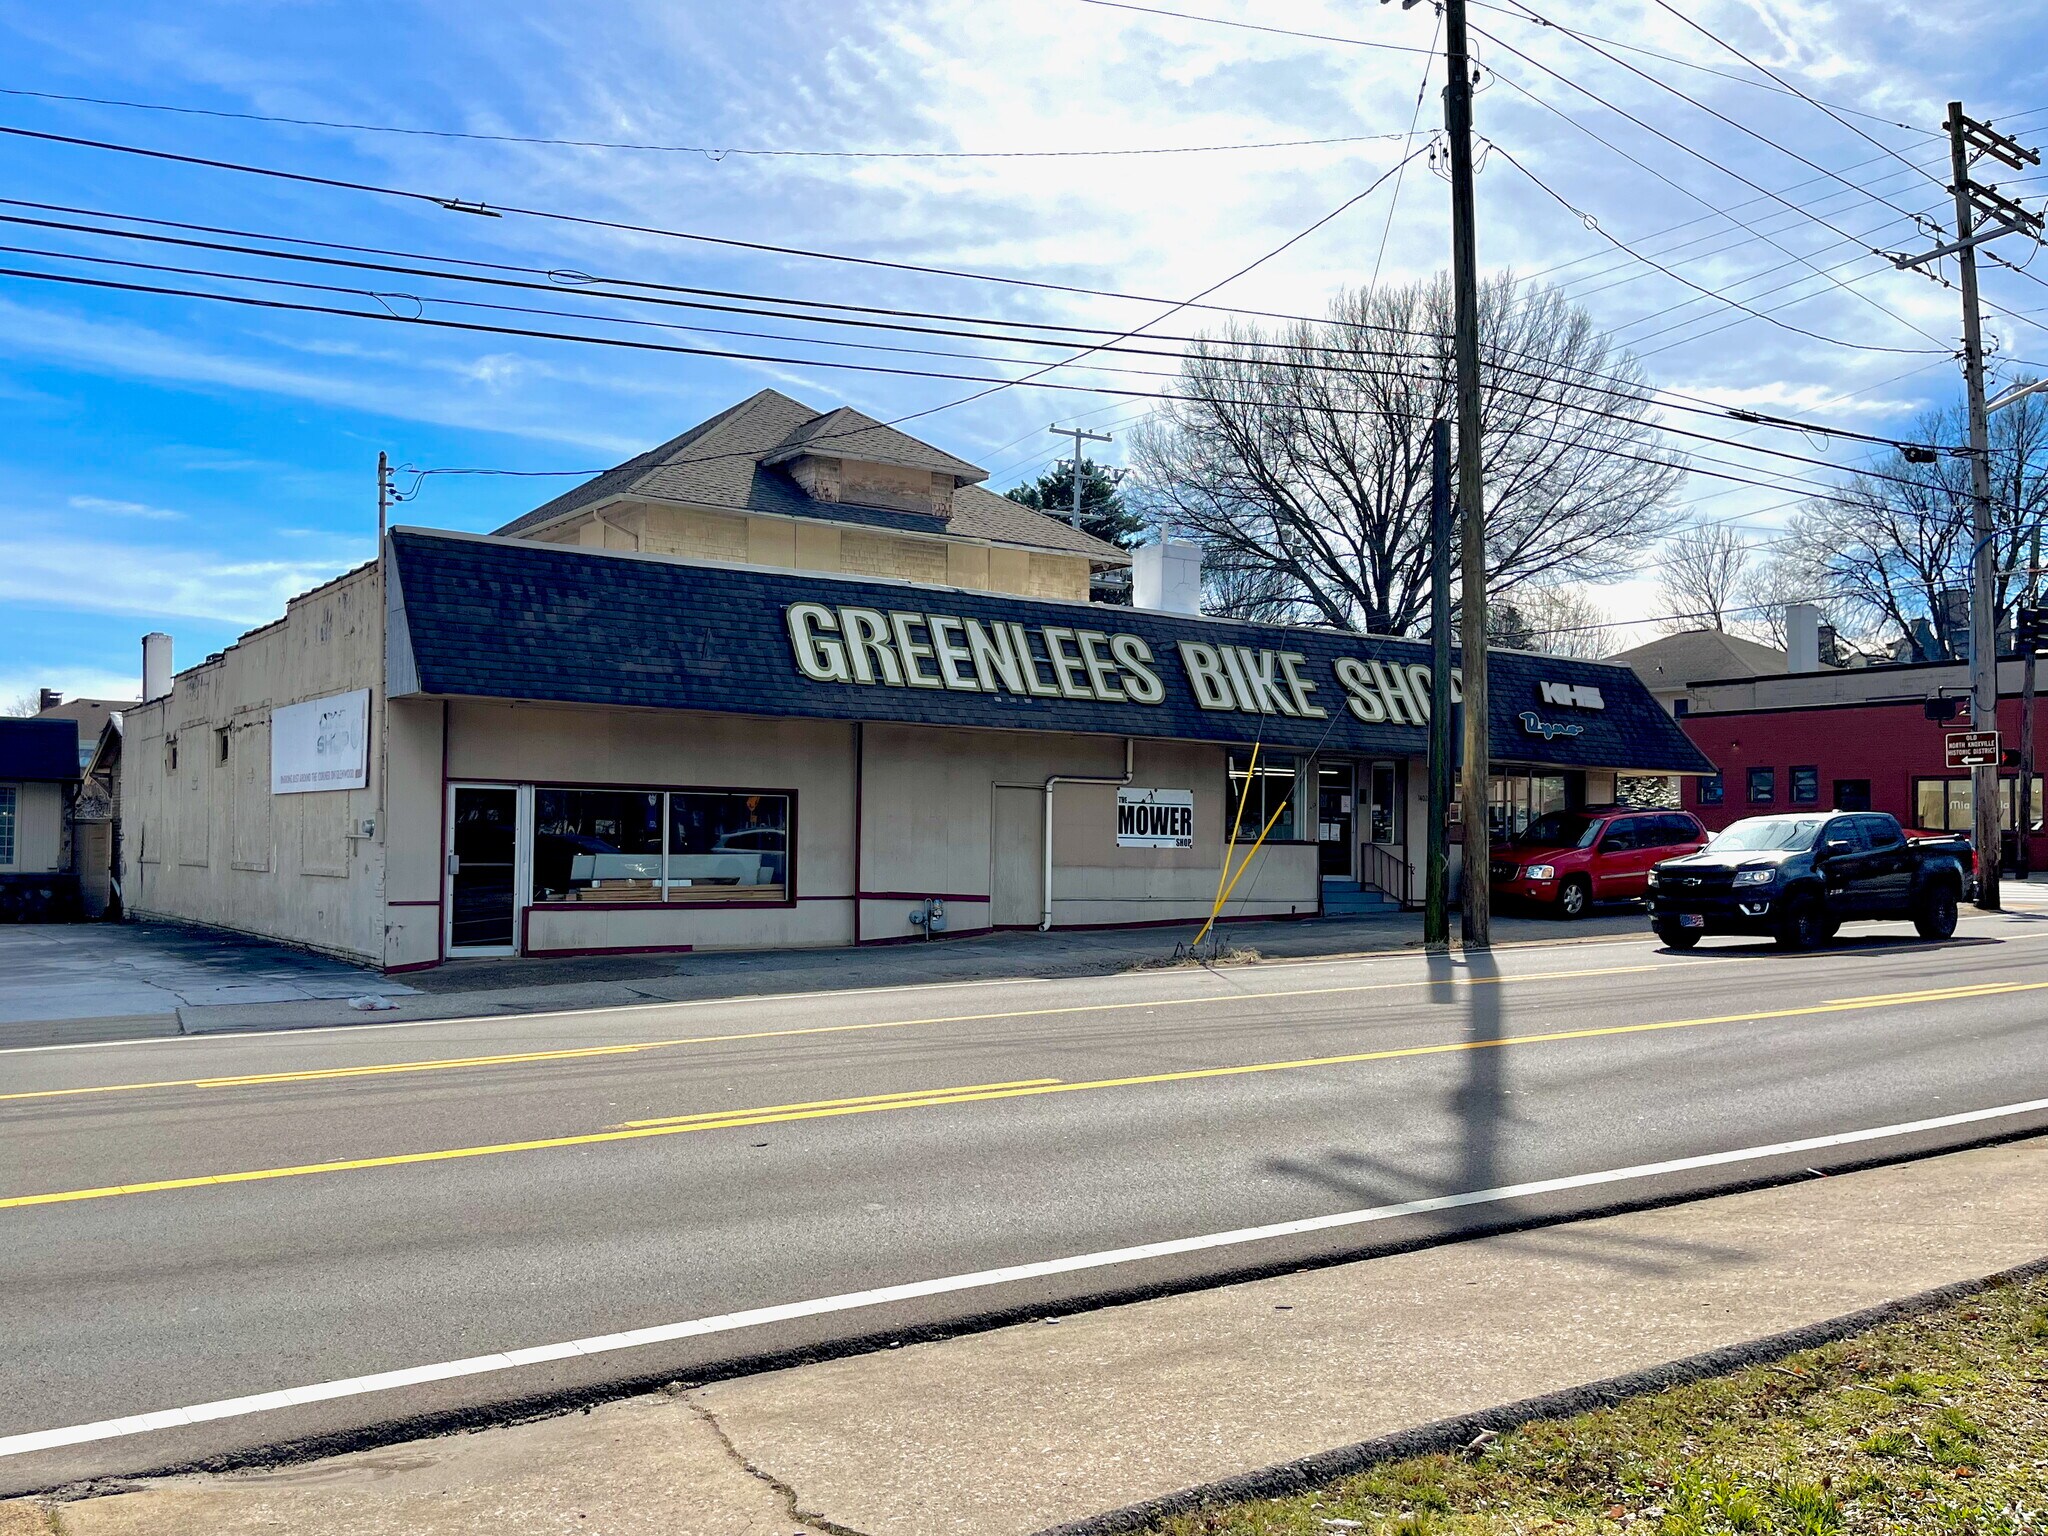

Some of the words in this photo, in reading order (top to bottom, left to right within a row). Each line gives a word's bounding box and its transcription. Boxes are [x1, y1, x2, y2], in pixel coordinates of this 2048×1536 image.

[786, 601, 1166, 705] GREENLEES
[1177, 640, 1328, 718] BIKE
[1540, 681, 1605, 710] KHS
[1950, 801, 1970, 809] Mia
[1118, 805, 1192, 836] MOWER
[1176, 838, 1192, 847] SHOP
